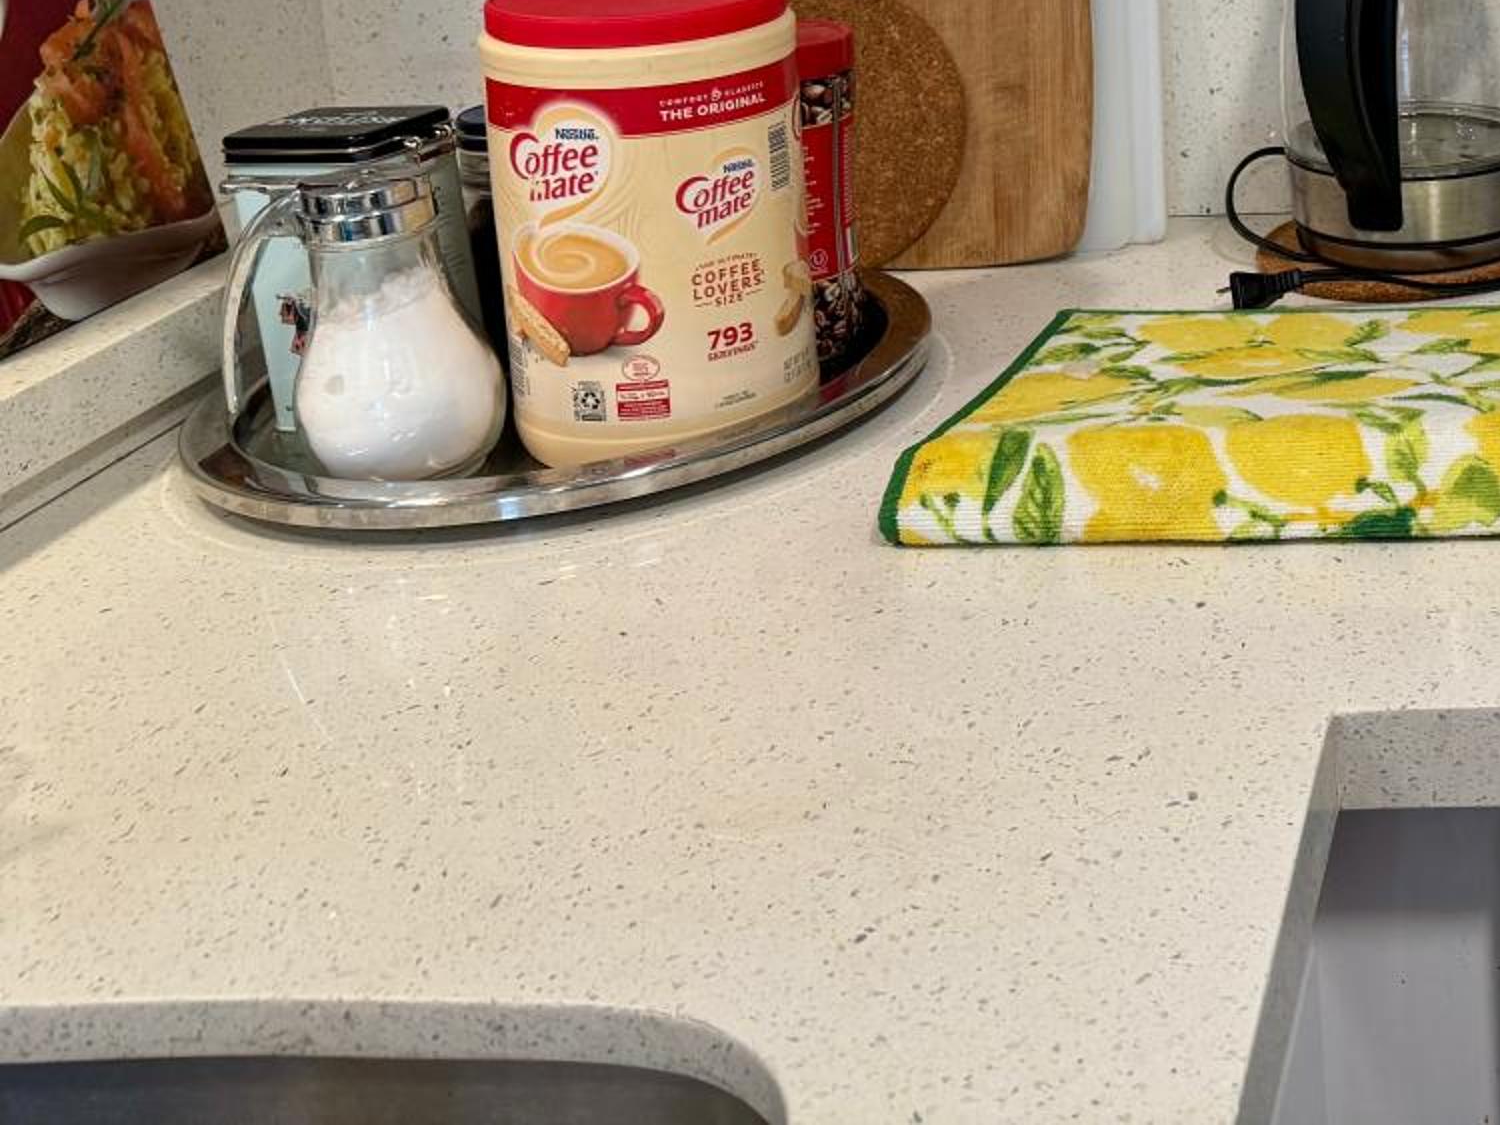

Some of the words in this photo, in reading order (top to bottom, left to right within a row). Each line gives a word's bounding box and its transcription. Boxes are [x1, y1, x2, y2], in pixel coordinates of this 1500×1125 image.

[659, 106, 693, 122] THE
[697, 92, 766, 116] ORIGINAL
[509, 131, 599, 180] Coffee
[675, 170, 755, 215] Coffee
[696, 190, 752, 229] mate
[692, 258, 761, 286] COFFEE
[715, 292, 743, 306] SIZE
[707, 322, 753, 351] 793
